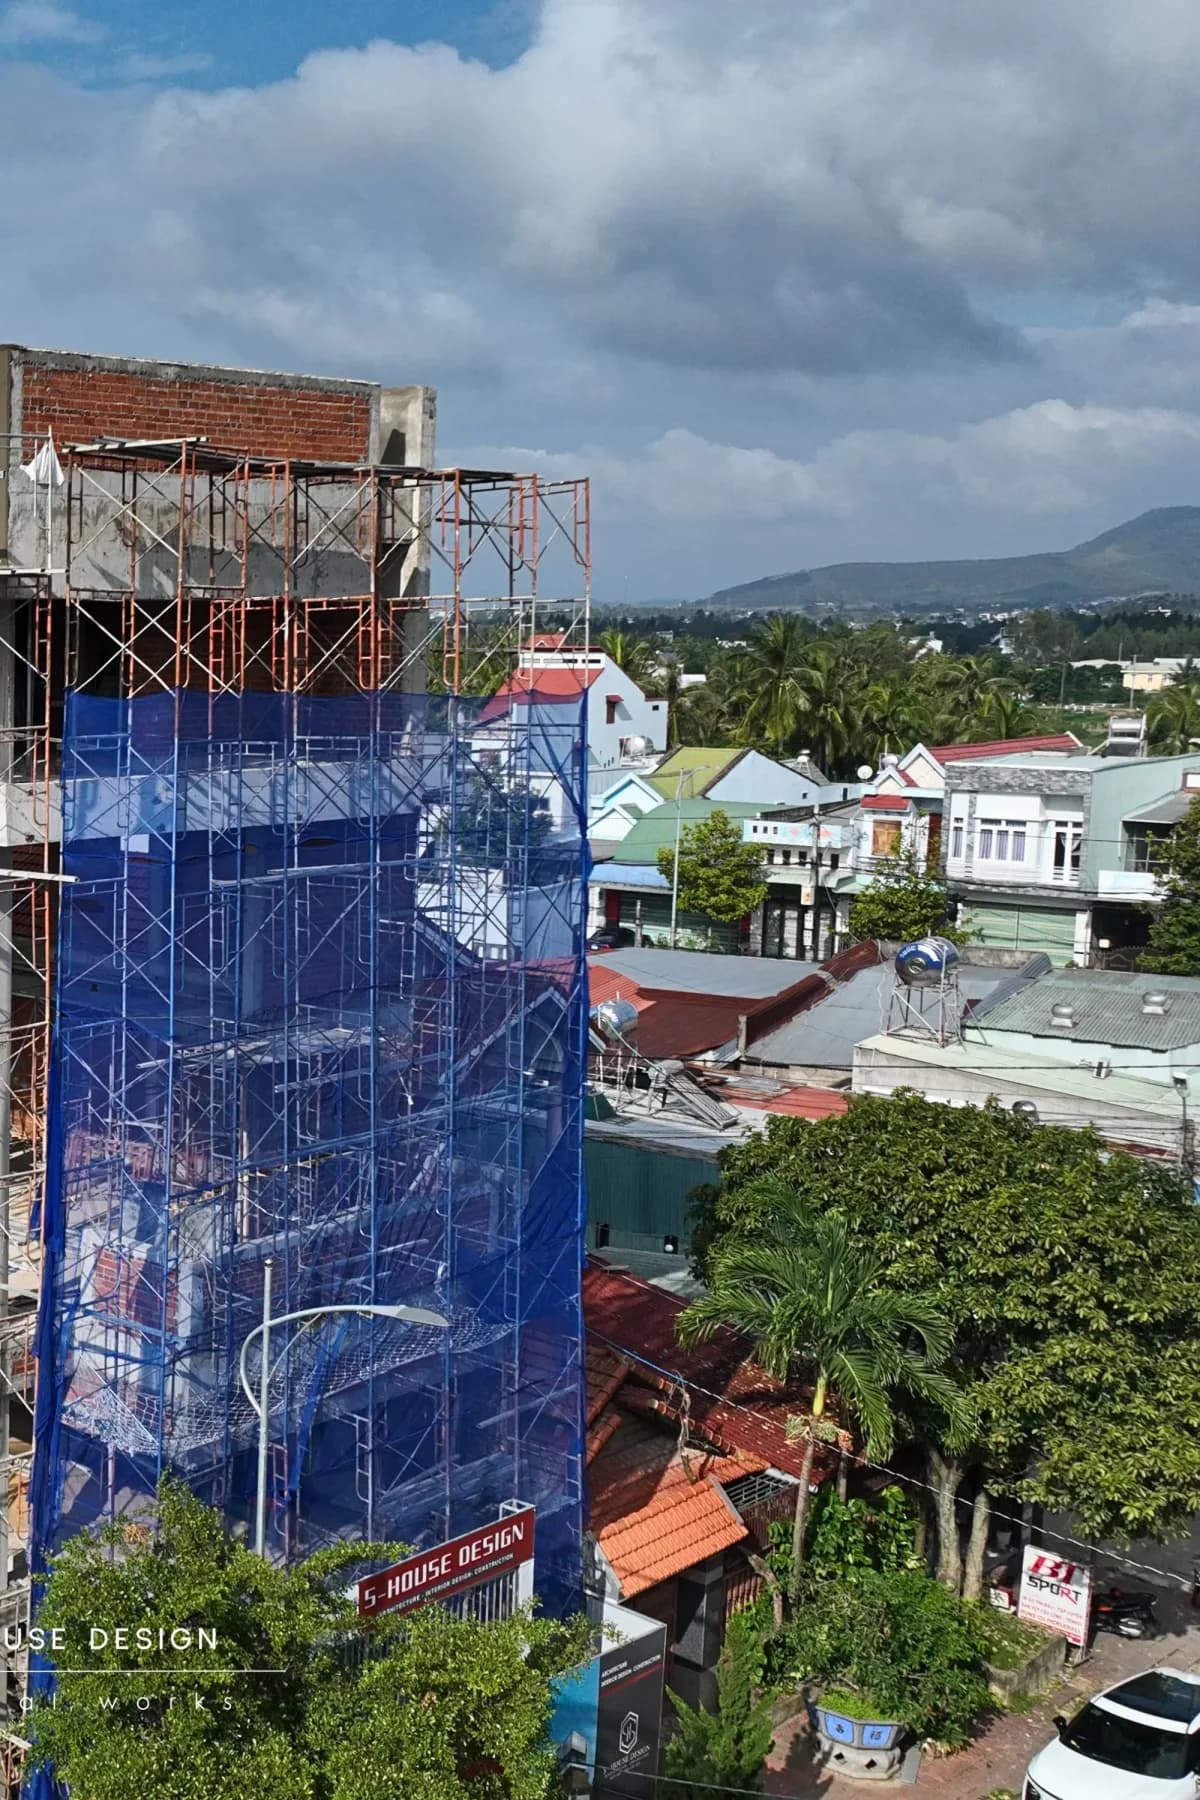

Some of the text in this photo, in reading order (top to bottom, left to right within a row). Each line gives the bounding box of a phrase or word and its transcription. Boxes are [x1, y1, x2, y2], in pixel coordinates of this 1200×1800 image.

[364, 1521, 524, 1610] S-HOUSE DESIGN
[474, 1552, 514, 1575] CONSTRUCTION
[1026, 1575, 1082, 1605] SPORT
